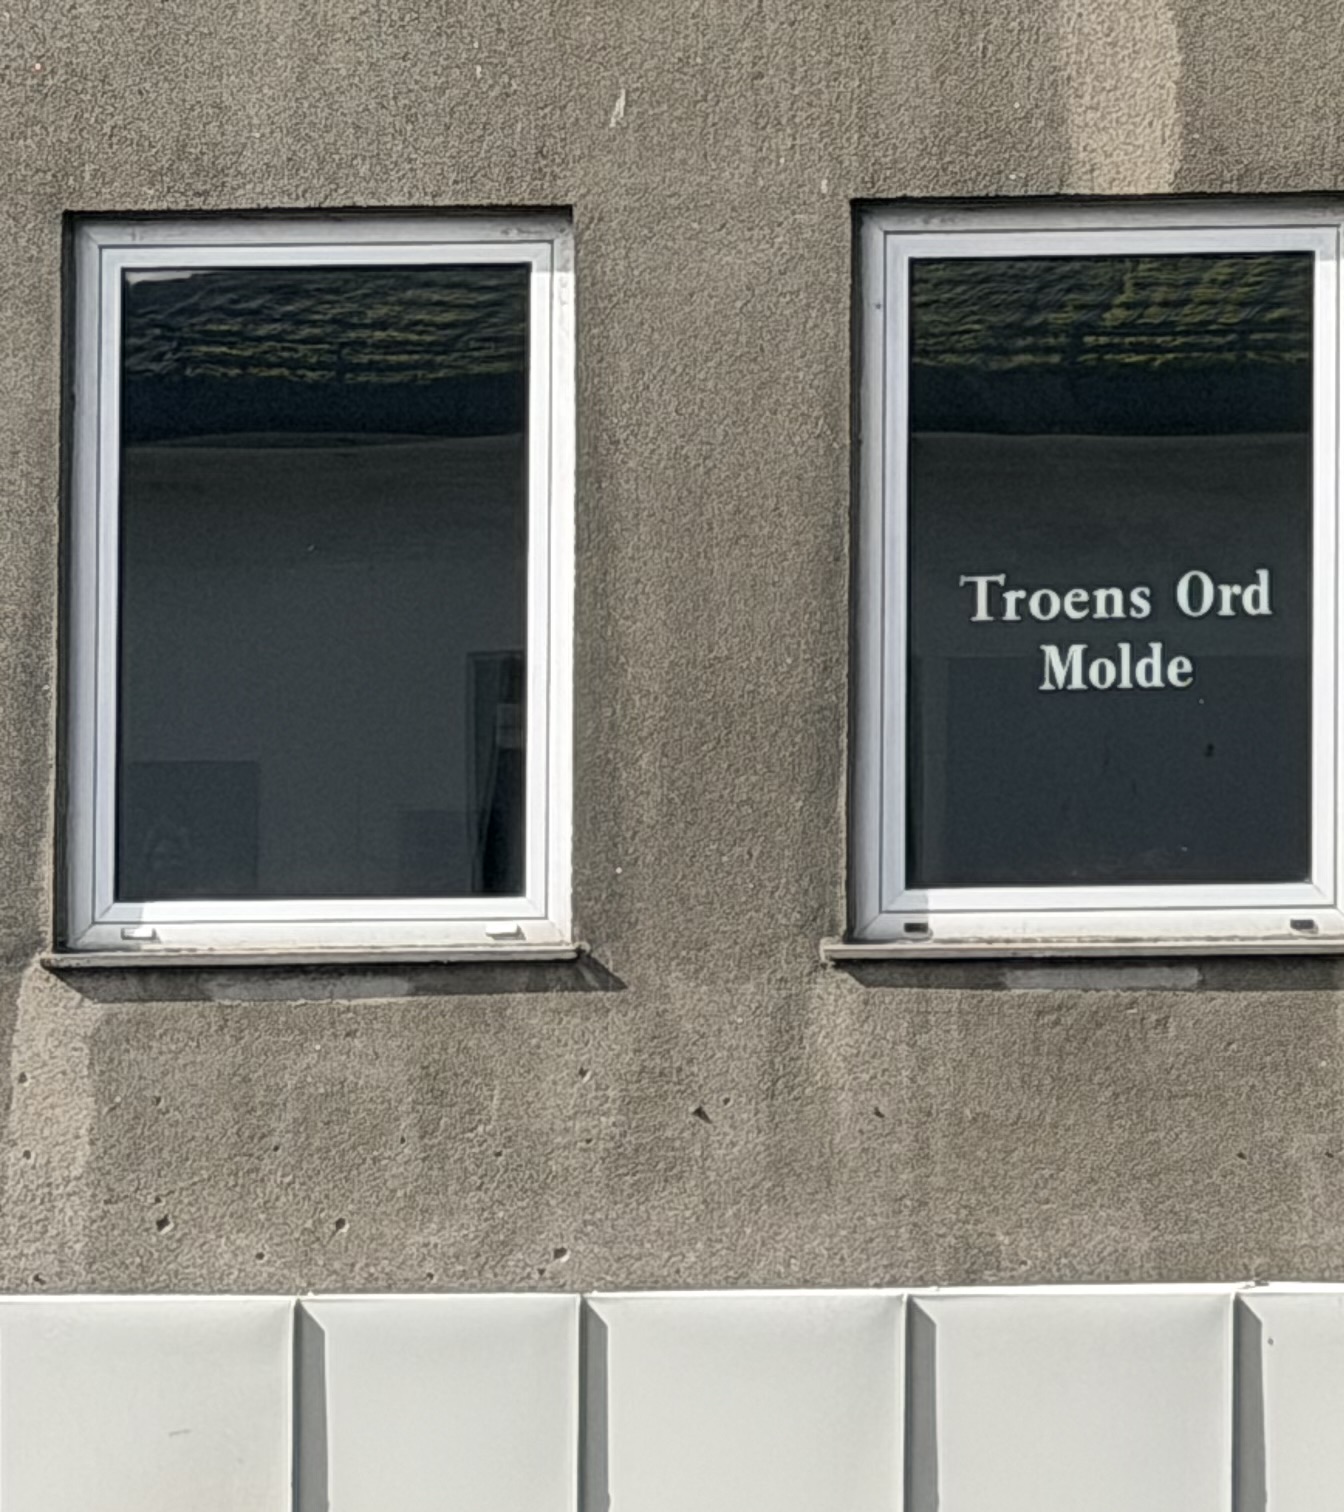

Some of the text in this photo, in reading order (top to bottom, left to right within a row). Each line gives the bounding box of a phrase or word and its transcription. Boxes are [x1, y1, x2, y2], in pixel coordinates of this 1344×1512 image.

[960, 569, 1273, 622] Troens Ord
[1038, 641, 1195, 692] Molde
